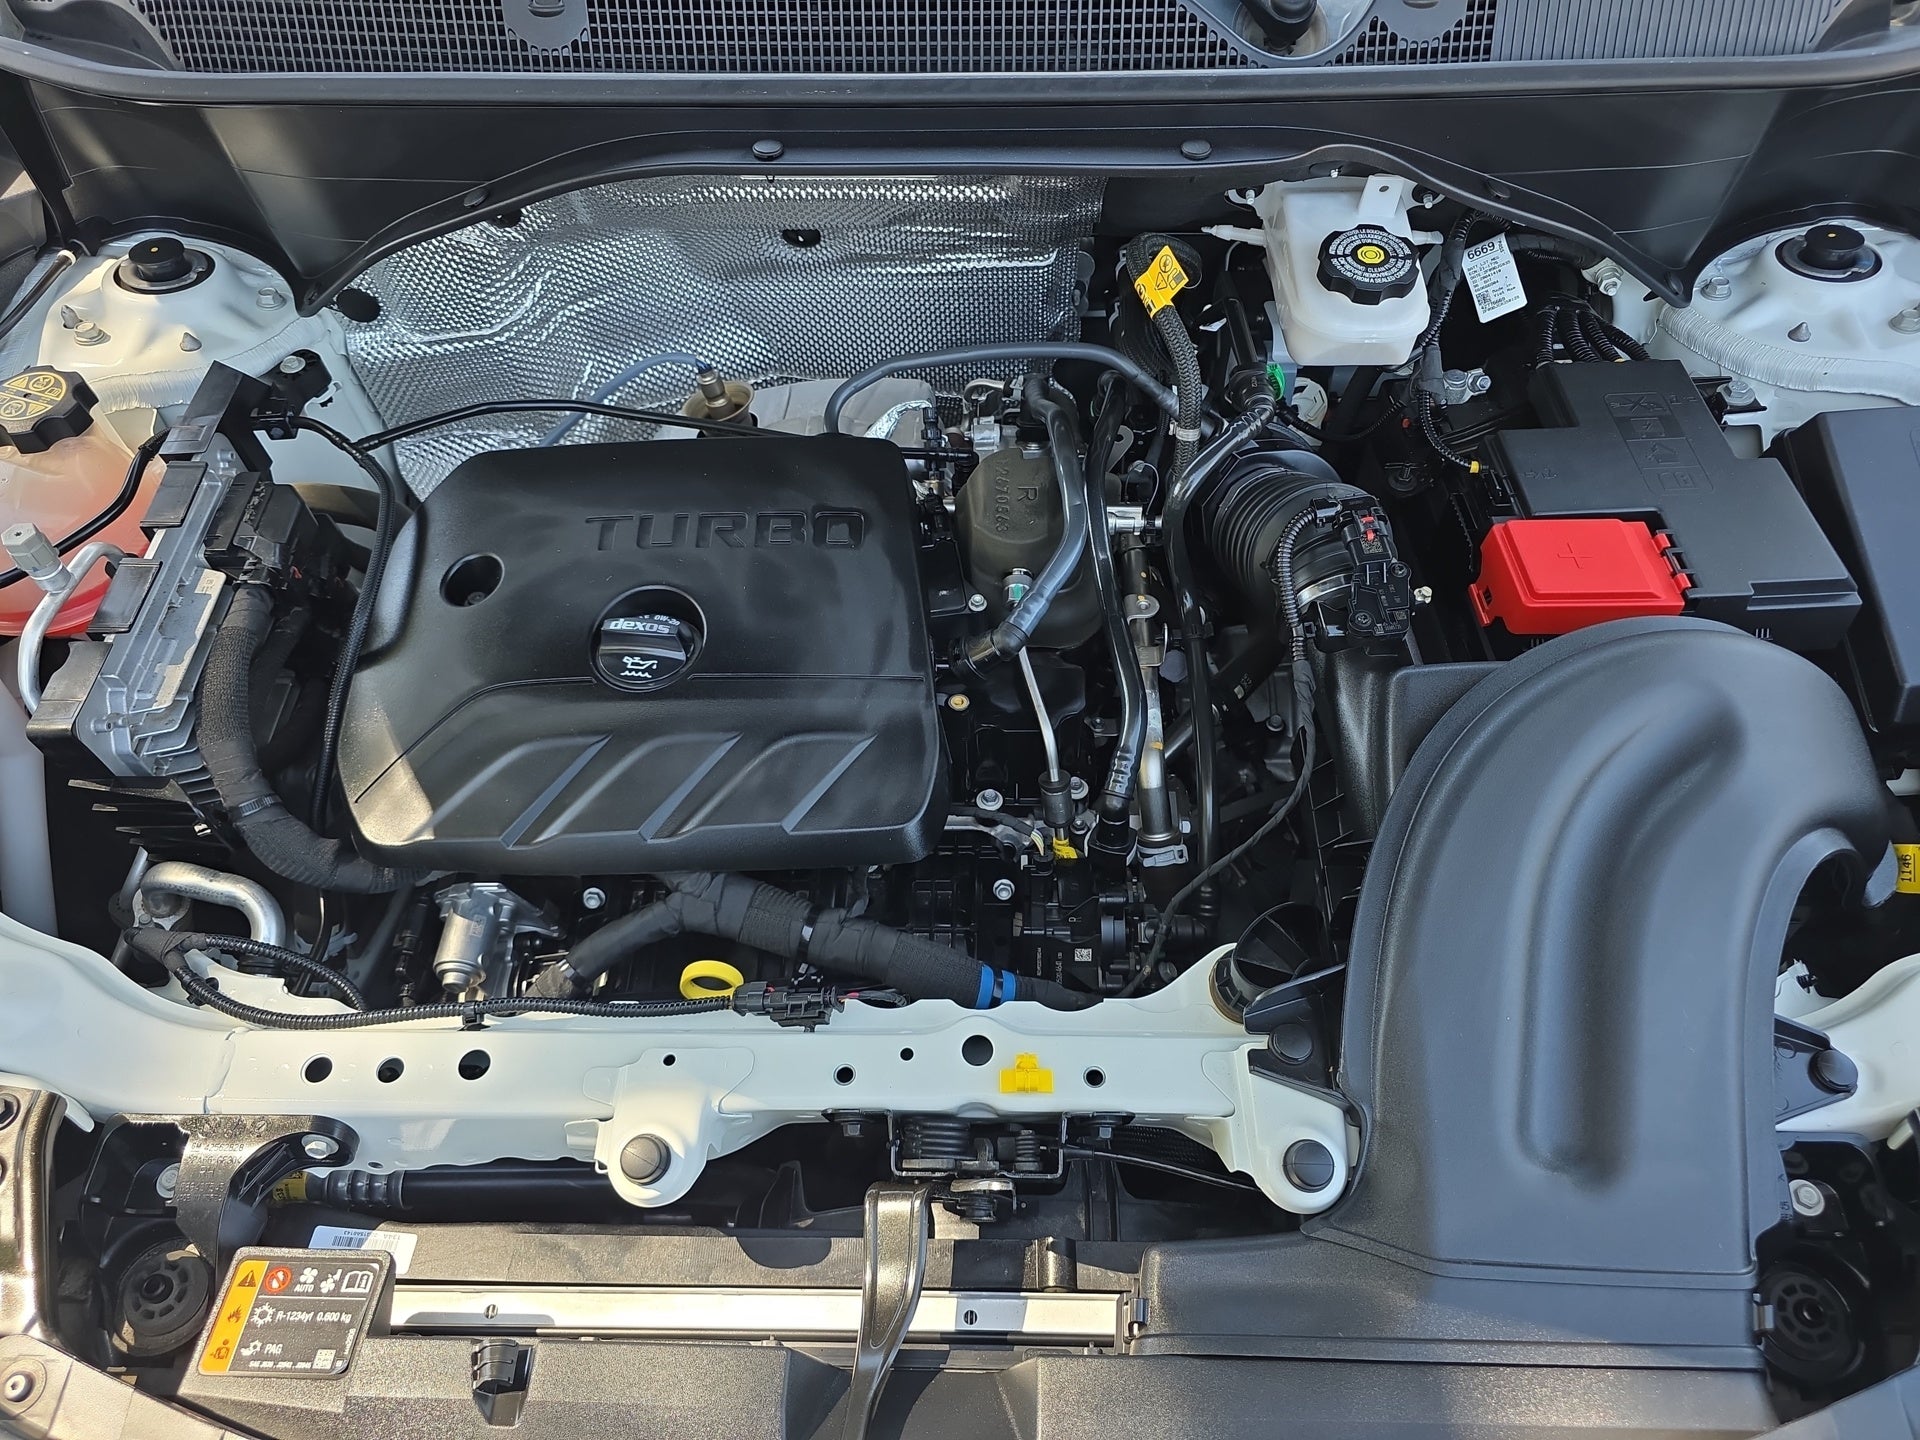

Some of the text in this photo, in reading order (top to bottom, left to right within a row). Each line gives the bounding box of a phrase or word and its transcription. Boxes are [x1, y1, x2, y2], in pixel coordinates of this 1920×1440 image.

[1467, 241, 1496, 260] 6669
[1353, 274, 1370, 282] FROM
[1018, 486, 1038, 502] R
[585, 511, 866, 551] TURBO
[609, 618, 670, 634] dexos
[1900, 854, 1912, 882] 1146
[294, 1284, 314, 1292] AUTO
[276, 1310, 352, 1324] R-1234yf 0.600 kg
[264, 1343, 283, 1354] PAG
